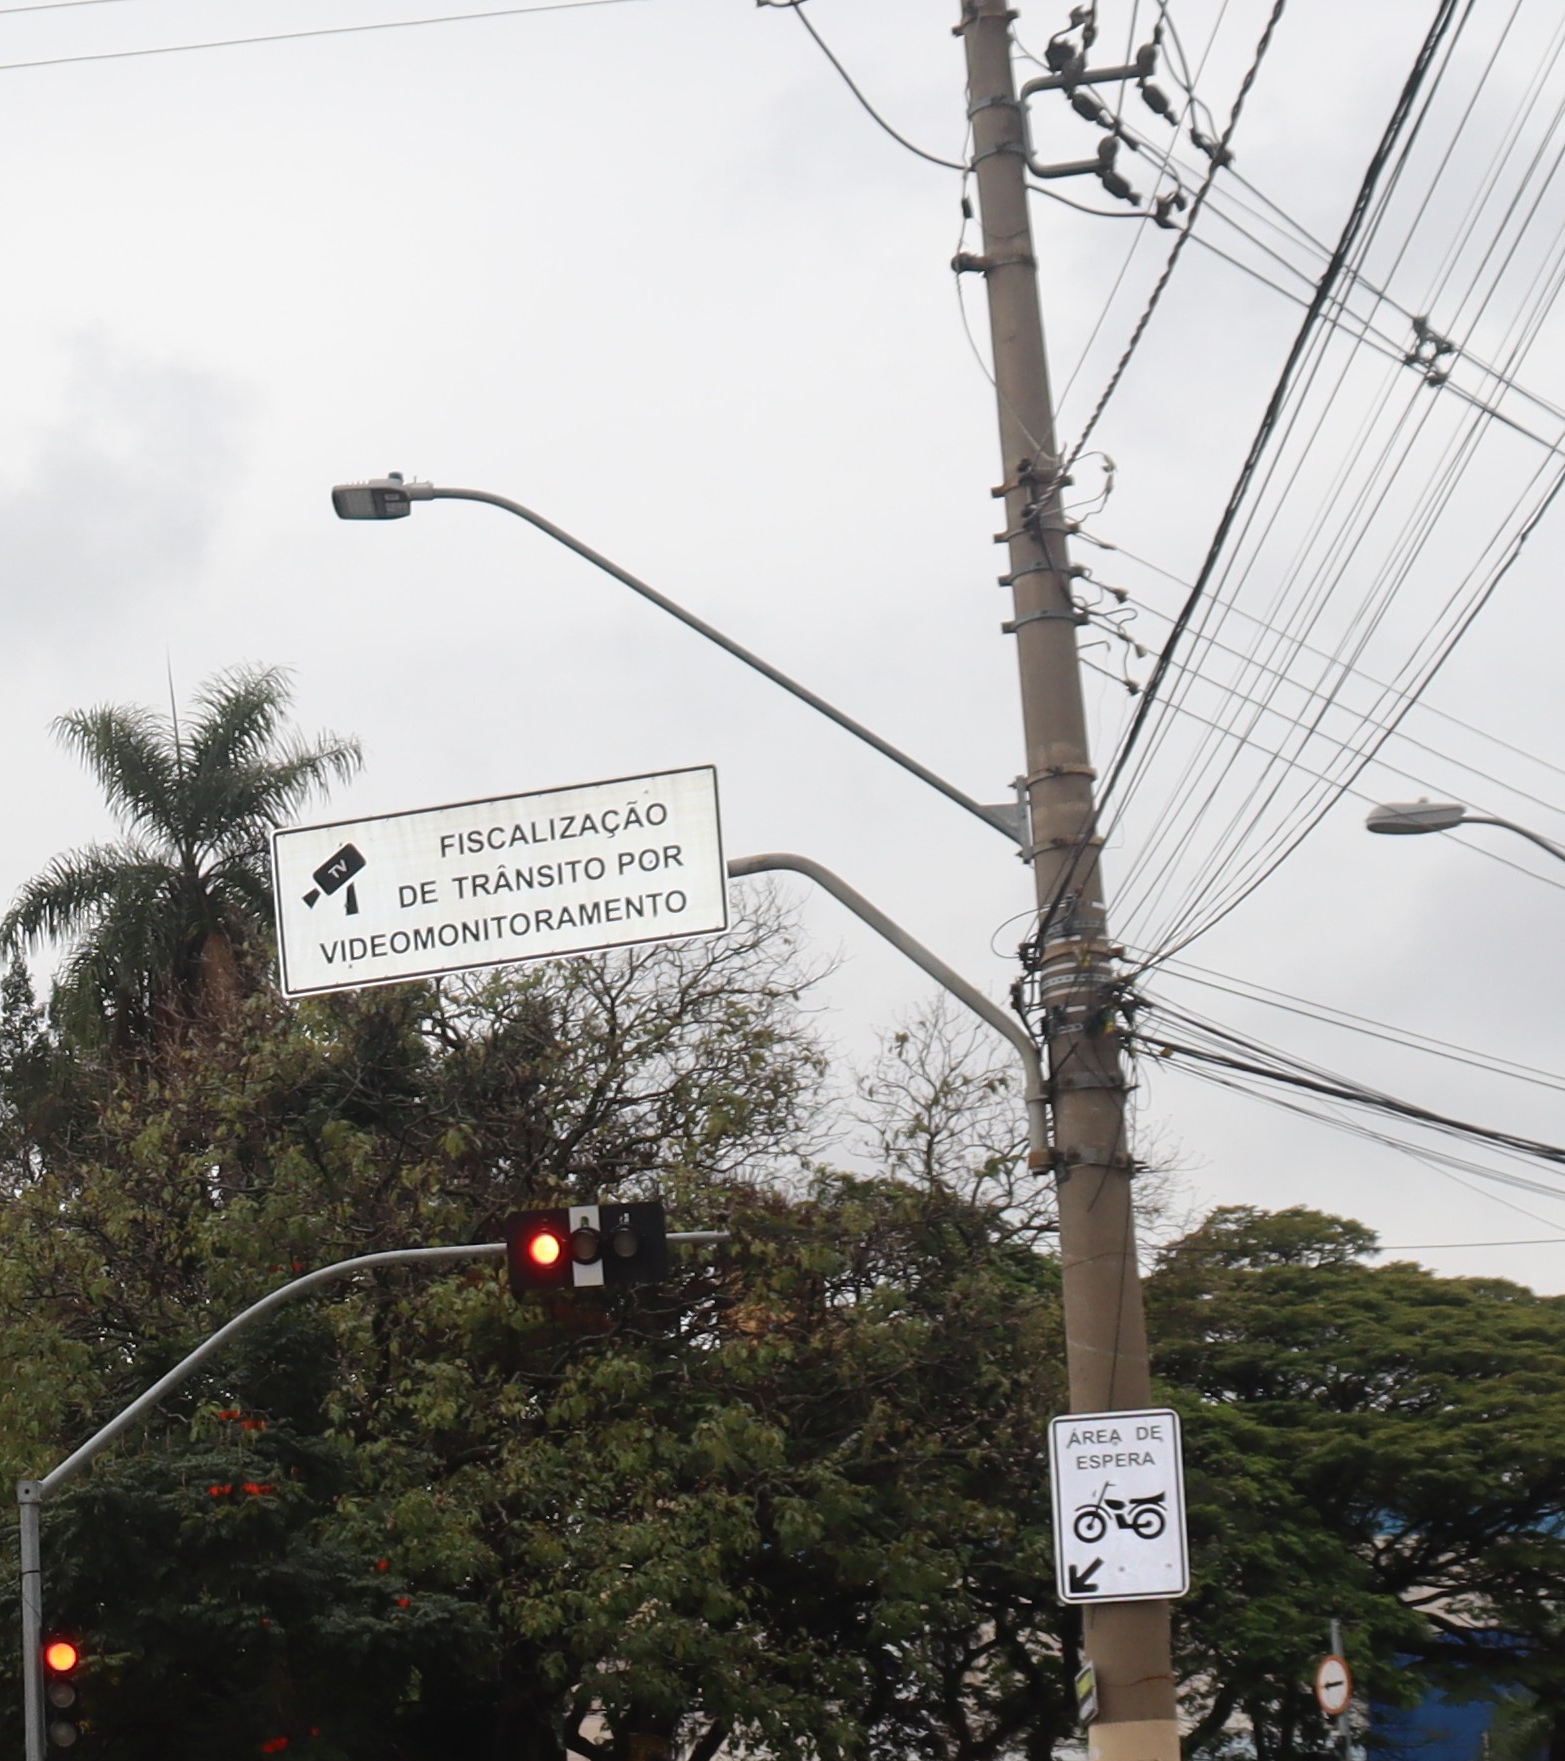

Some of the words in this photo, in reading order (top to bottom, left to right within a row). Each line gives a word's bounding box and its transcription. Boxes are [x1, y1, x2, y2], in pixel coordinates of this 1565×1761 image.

[440, 801, 668, 858] FISCALIZAÇÃO
[327, 859, 347, 878] TV
[399, 880, 438, 908] DE
[452, 857, 605, 900] TRÂNSITO
[618, 844, 684, 876] POR
[320, 889, 688, 964] VIDEOMONITORAMENTO
[1067, 1428, 1122, 1448] ÁREA
[1136, 1425, 1164, 1442] DE
[1077, 1451, 1155, 1470] ESPERA
